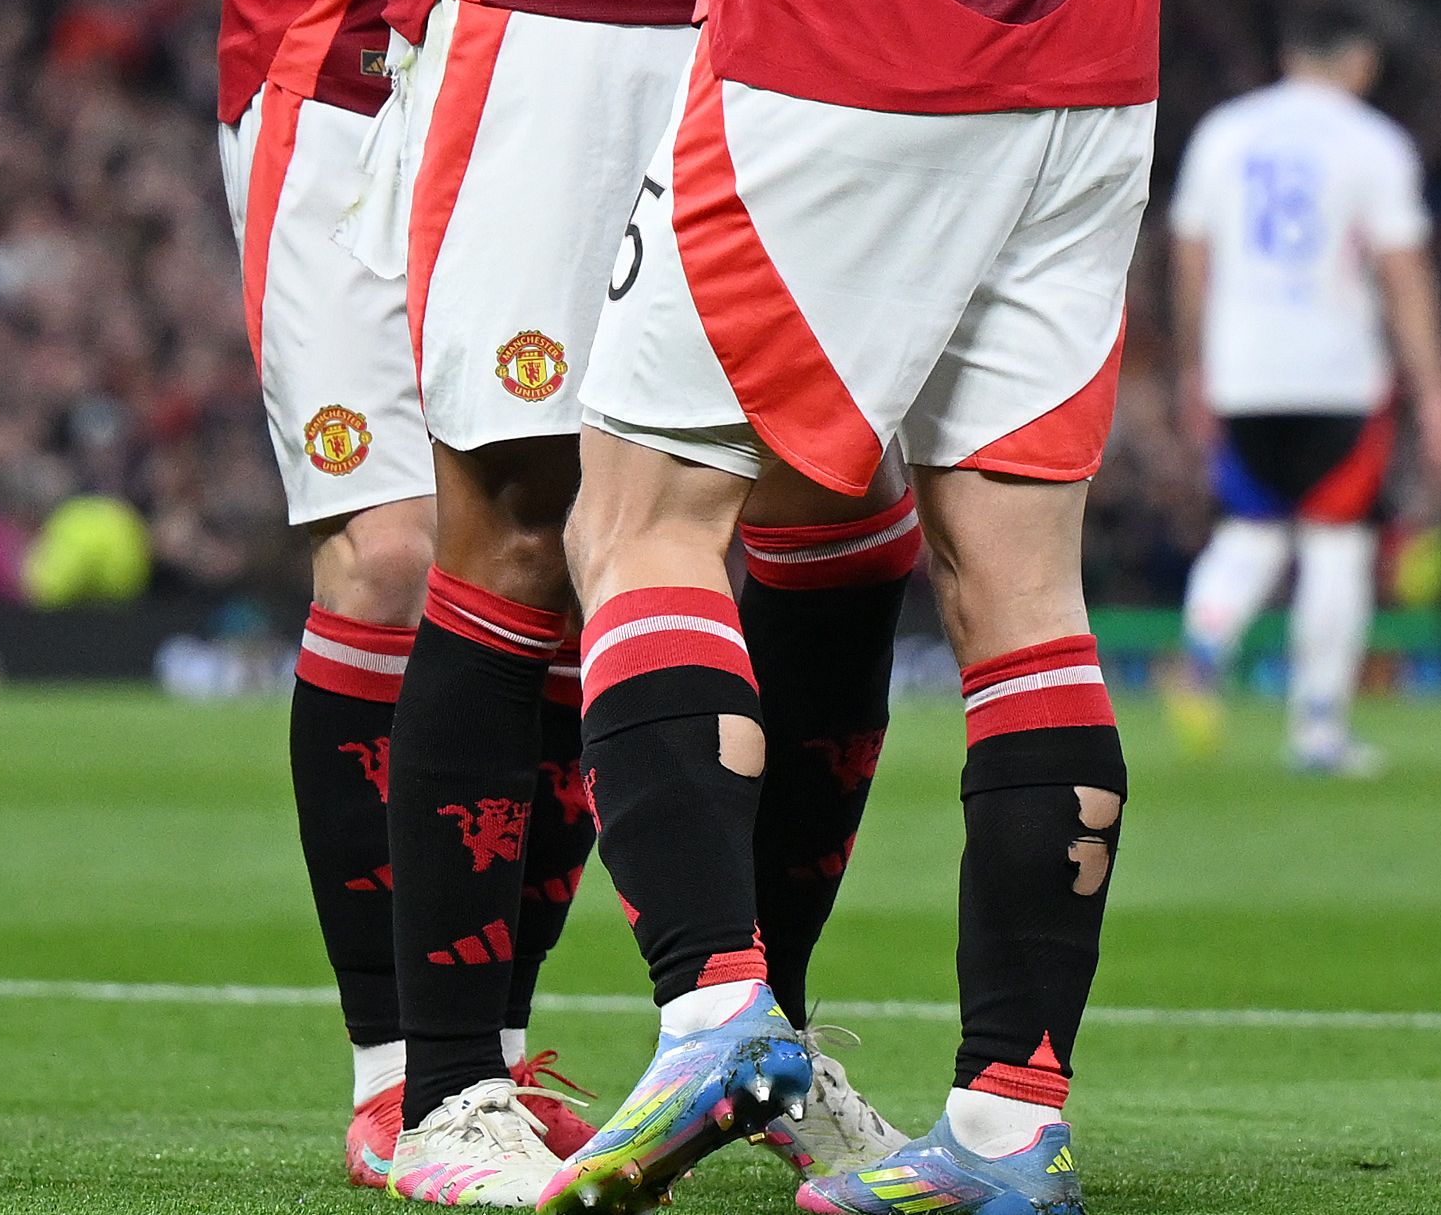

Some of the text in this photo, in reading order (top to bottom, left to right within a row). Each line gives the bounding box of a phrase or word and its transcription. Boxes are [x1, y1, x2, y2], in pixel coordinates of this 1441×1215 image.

[502, 335, 560, 361] MANCHESTER
[514, 384, 554, 398] UNITED
[308, 409, 363, 437] MANCHESTER
[322, 455, 361, 472] UNITED
